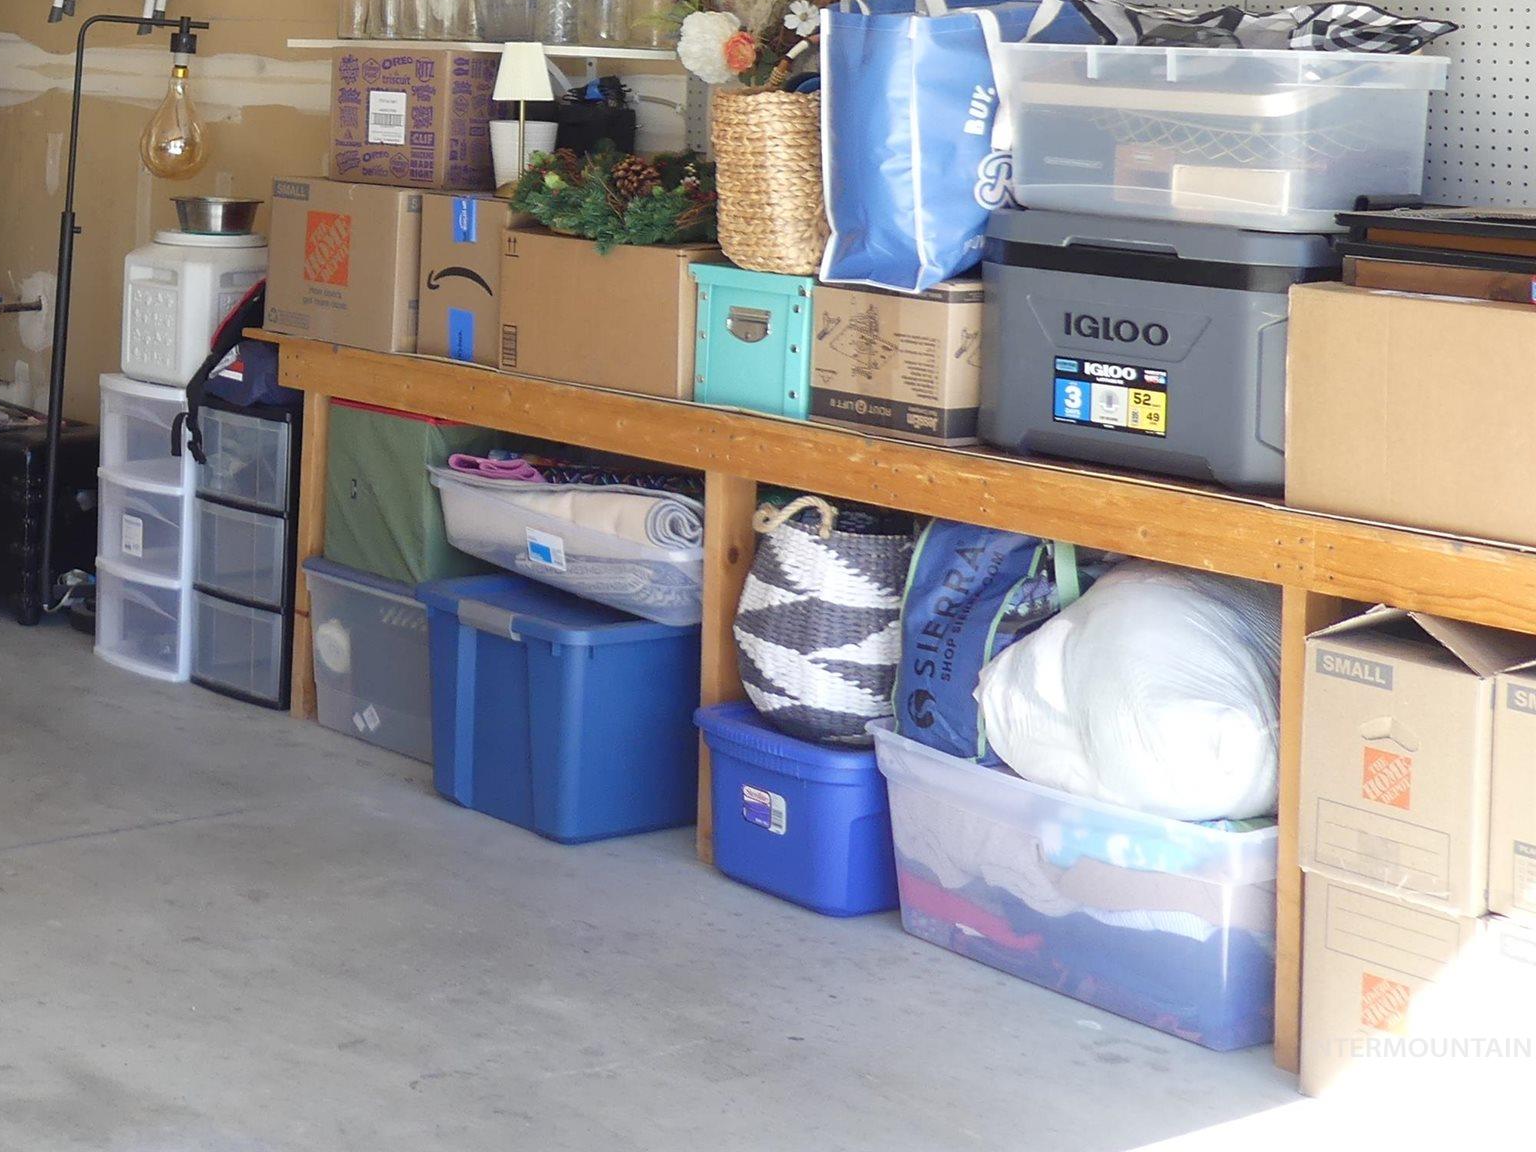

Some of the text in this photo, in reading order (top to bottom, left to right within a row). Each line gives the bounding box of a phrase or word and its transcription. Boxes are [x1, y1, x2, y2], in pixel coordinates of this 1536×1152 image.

[382, 56, 413, 70] OREO
[1064, 312, 1169, 346] IGLOO
[1084, 362, 1137, 381] IGLOO
[1064, 385, 1082, 409] 3
[1134, 392, 1152, 406] 52
[1146, 412, 1160, 422] 49
[915, 546, 985, 679] SIERRA
[941, 637, 959, 682] SHOP
[1322, 654, 1386, 685] SMALL
[1364, 755, 1411, 797] HOME
